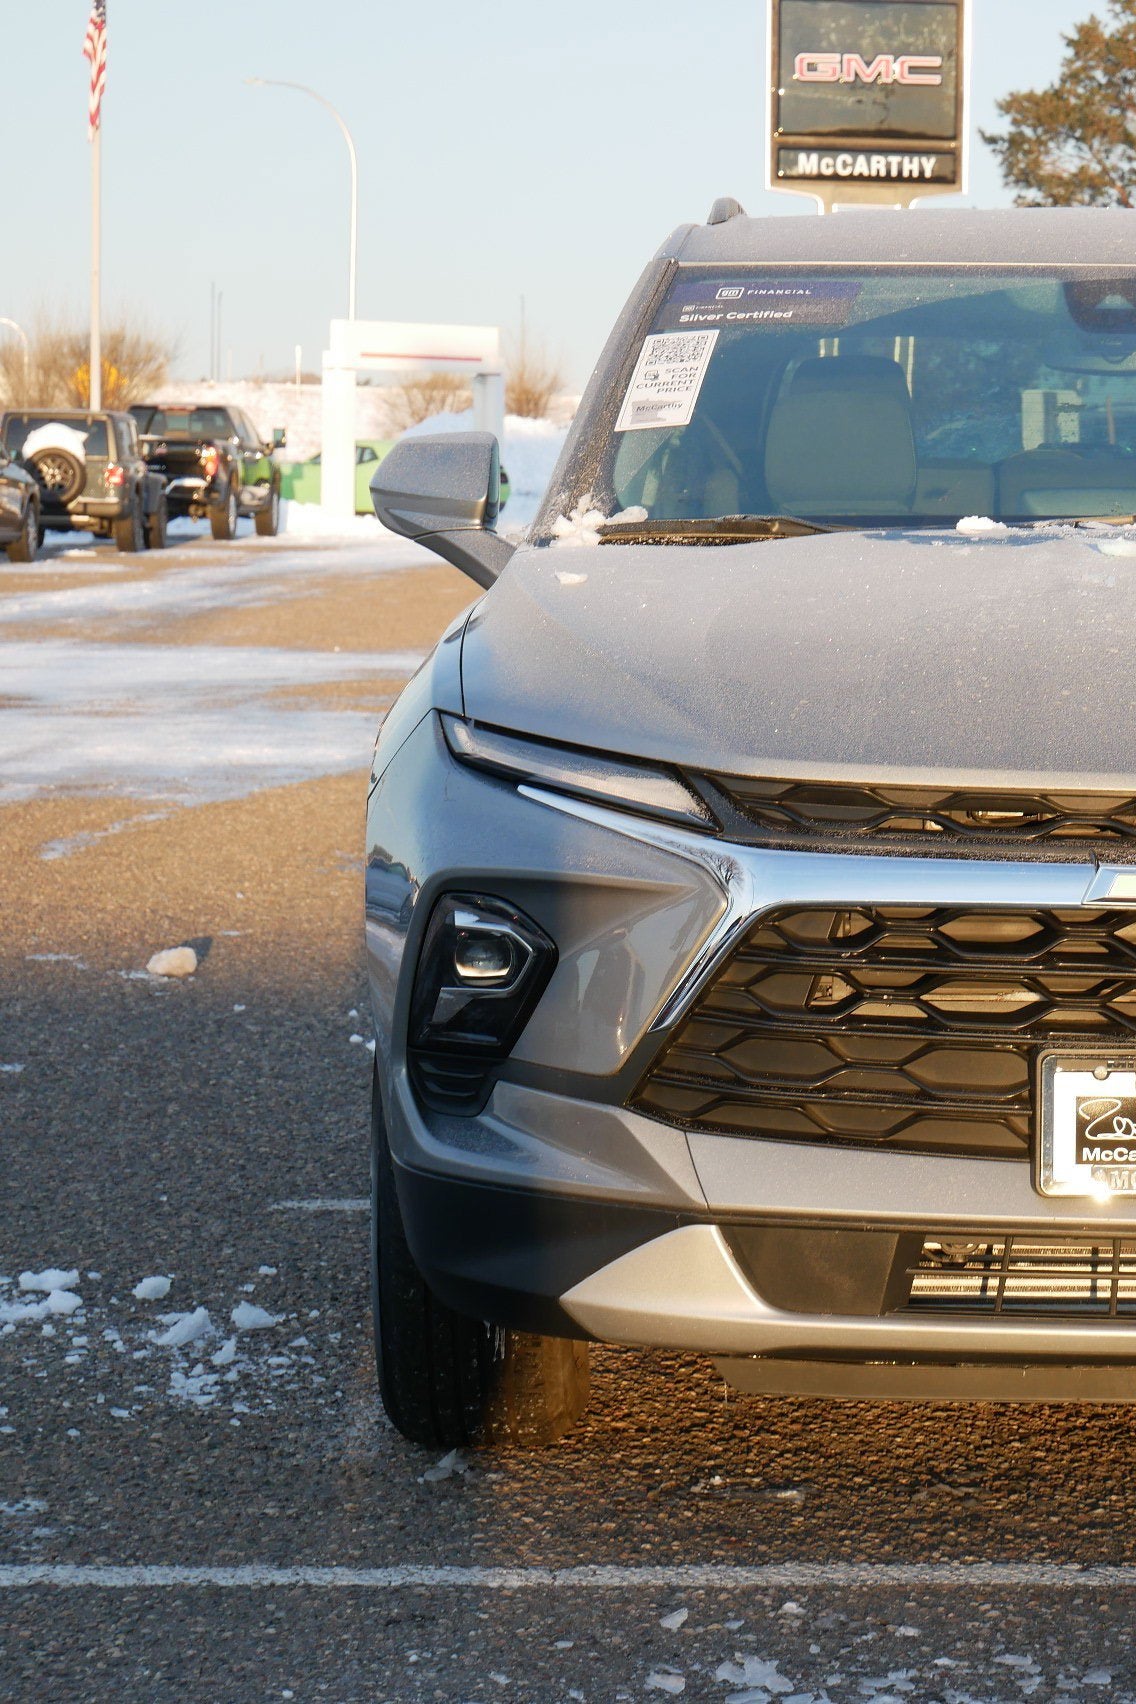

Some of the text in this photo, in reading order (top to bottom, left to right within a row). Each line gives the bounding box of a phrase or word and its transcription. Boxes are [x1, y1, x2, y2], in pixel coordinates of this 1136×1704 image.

[794, 52, 943, 86] GMC
[797, 152, 937, 179] McCARTHY
[747, 288, 813, 296] FINANCIAL
[679, 310, 793, 323] Silver Certified
[665, 366, 699, 375] SCAN
[636, 379, 695, 390] CURRENT
[656, 386, 694, 394] PRICE
[636, 402, 683, 412] McCarthy
